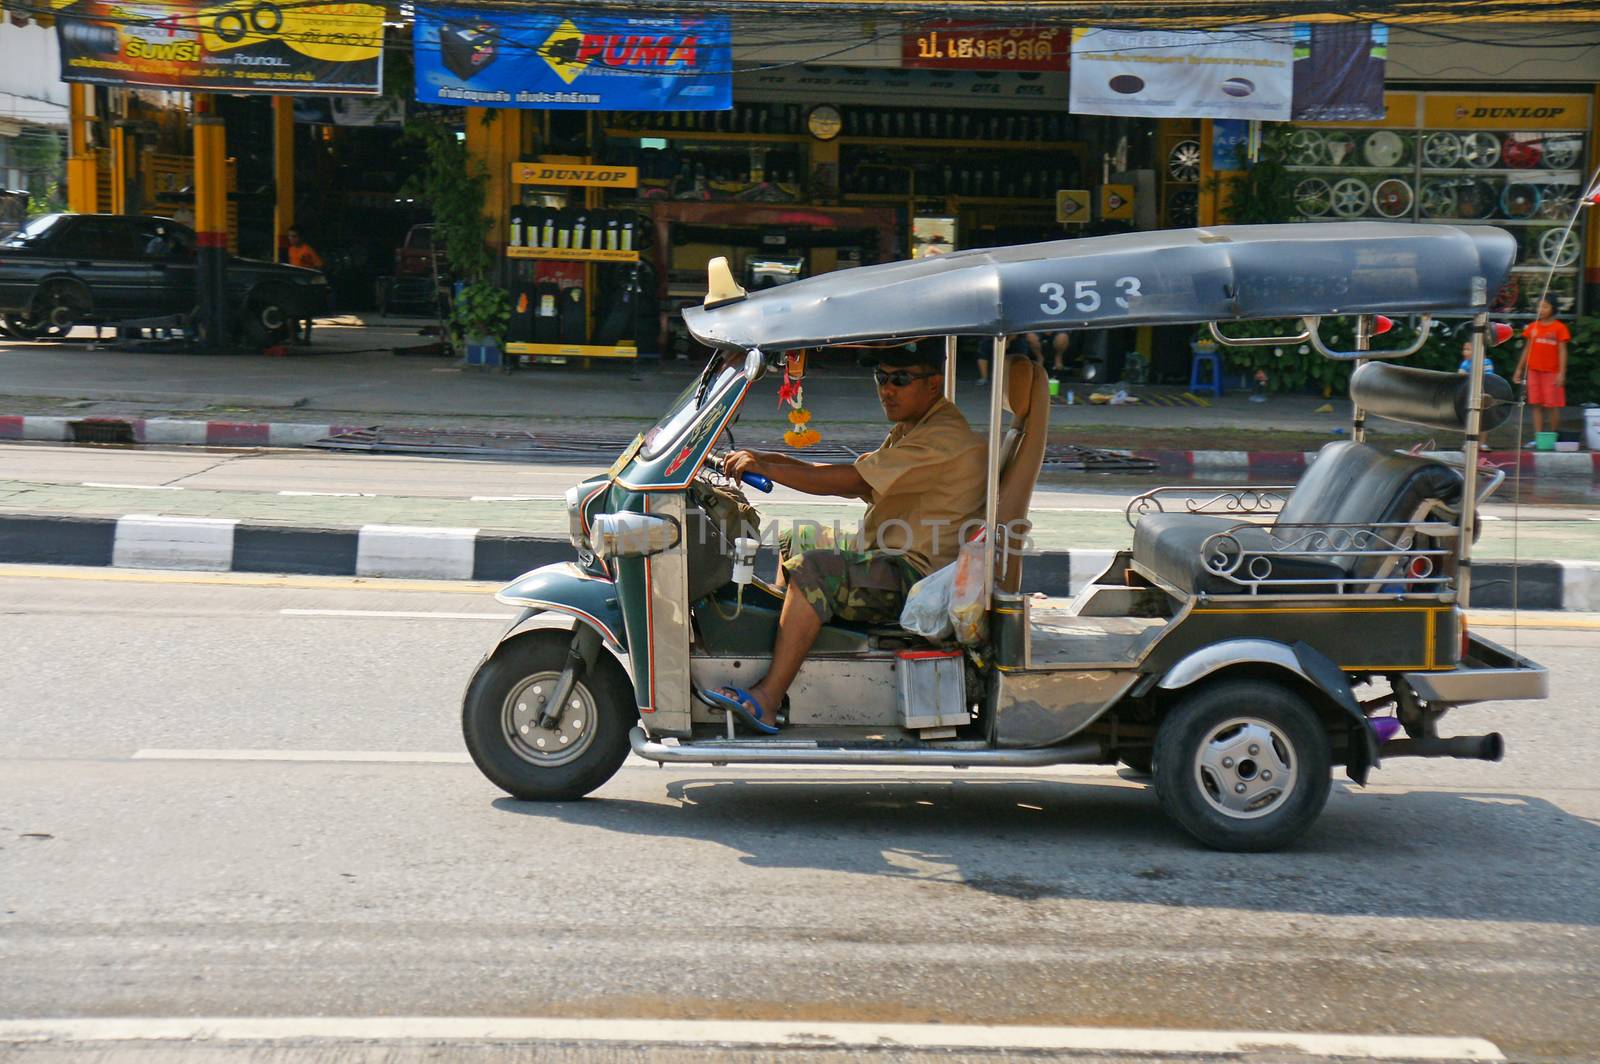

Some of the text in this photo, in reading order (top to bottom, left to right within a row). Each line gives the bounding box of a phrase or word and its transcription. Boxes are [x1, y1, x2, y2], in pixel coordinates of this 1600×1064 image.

[125, 35, 201, 62] รับฟรี!
[576, 34, 699, 66] PUMA
[917, 32, 943, 58] ป.
[1471, 107, 1566, 119] DUNLOP
[538, 169, 627, 182] DUNLOP
[1039, 276, 1142, 315] 353
